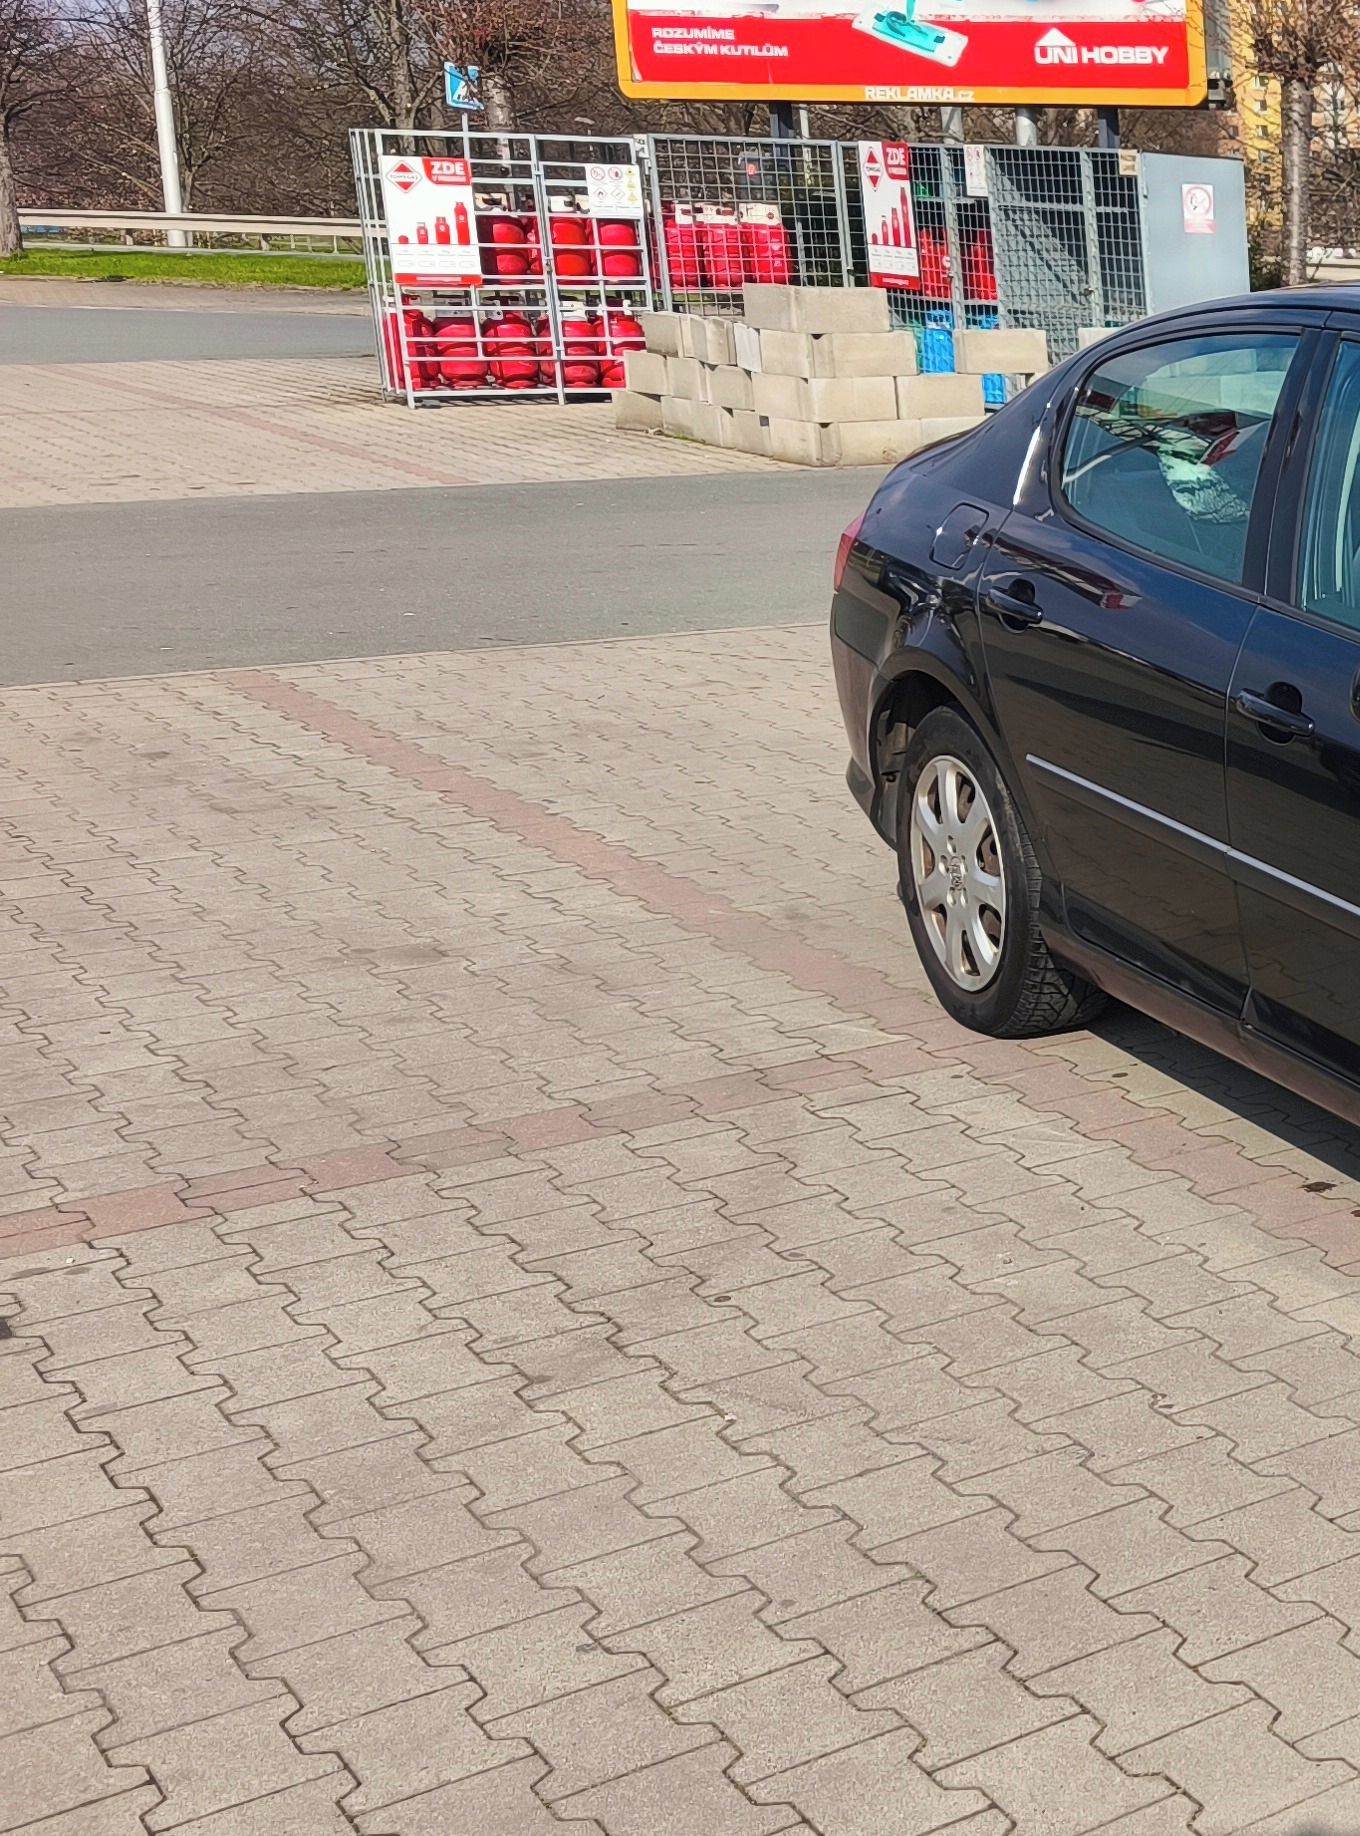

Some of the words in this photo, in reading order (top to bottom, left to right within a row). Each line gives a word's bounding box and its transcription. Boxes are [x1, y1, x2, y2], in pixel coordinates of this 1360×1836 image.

[651, 26, 735, 40] ROZUMÍME
[653, 41, 718, 55] ČESKÝM
[720, 43, 789, 57] KUTILŮM
[1034, 46, 1078, 64] UNI
[1081, 46, 1169, 65] HOBBY
[885, 147, 906, 166] ZDE
[430, 160, 465, 176] ZDE
